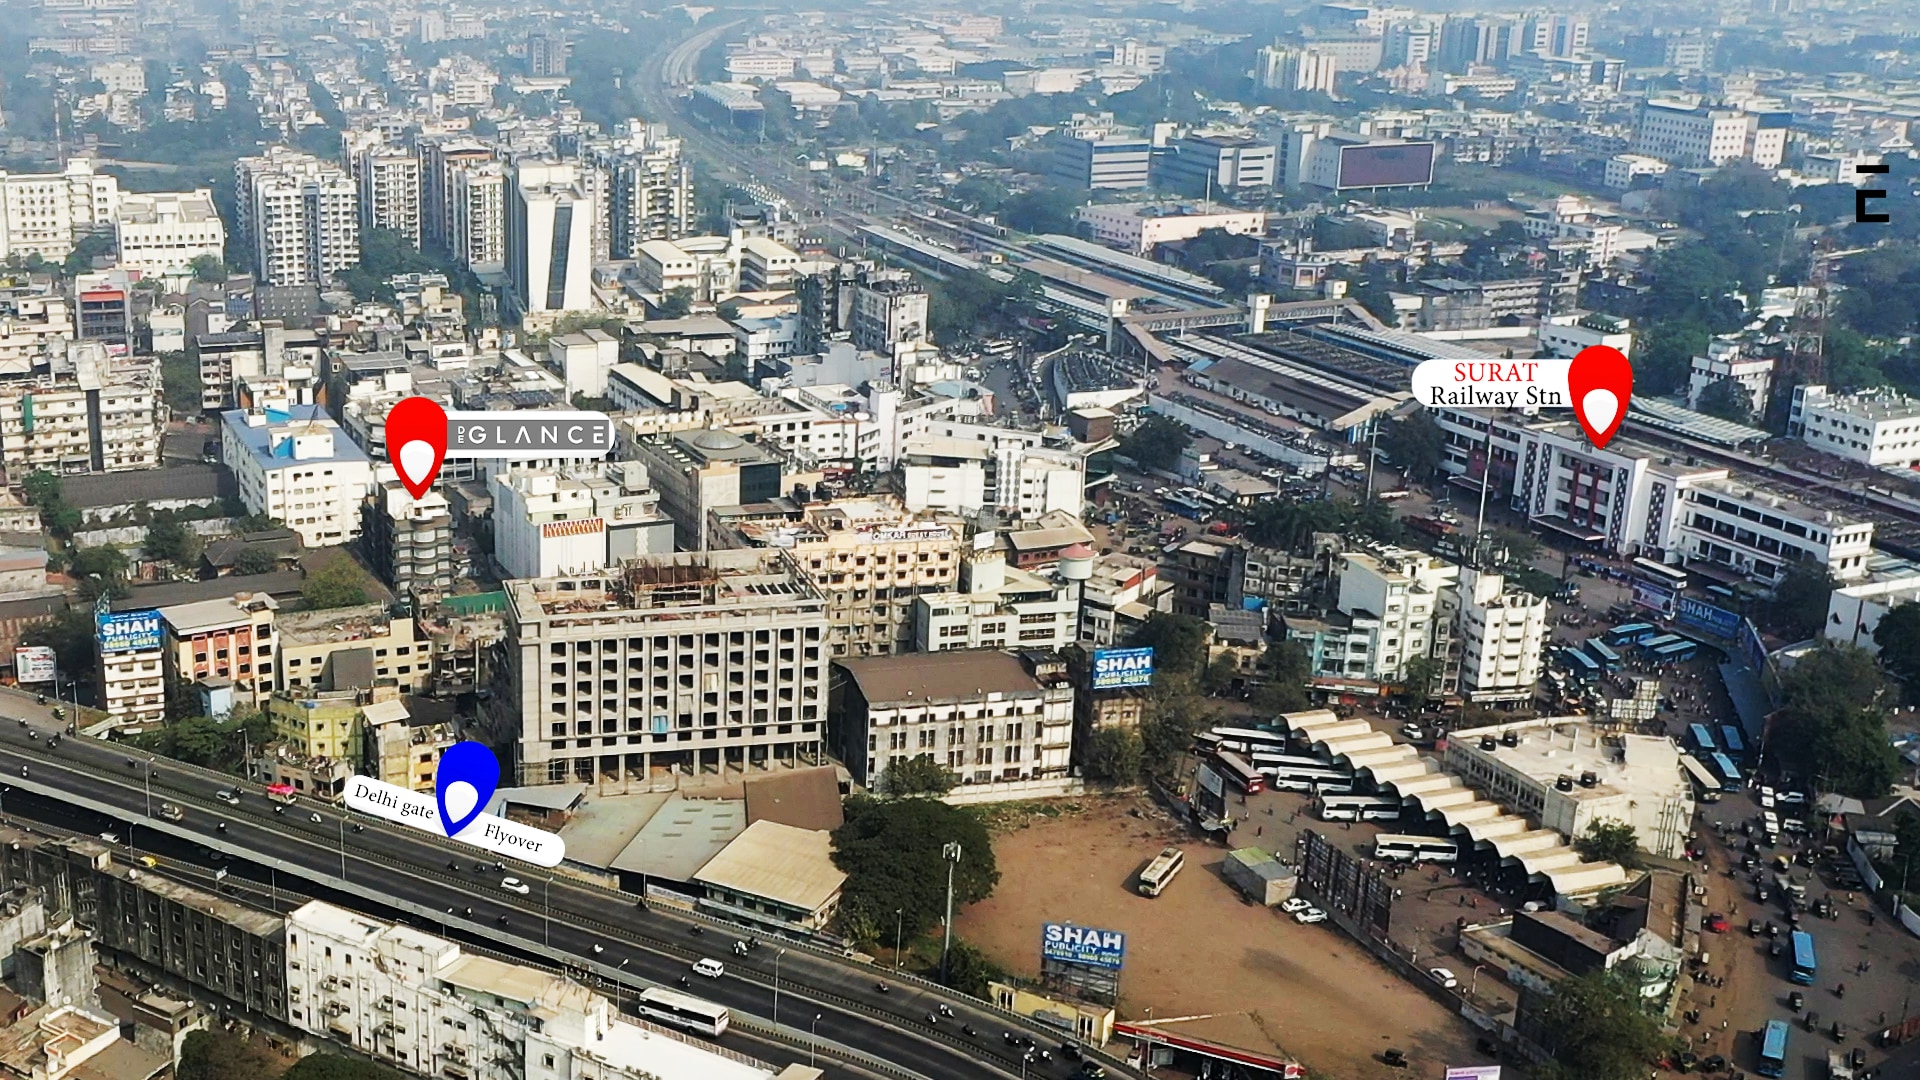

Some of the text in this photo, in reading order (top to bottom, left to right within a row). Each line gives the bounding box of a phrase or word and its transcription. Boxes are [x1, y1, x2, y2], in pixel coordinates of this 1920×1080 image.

[1680, 600, 1713, 621] SHAH
[103, 619, 159, 636] SHAH
[106, 632, 152, 642] PUBLICITY
[1096, 656, 1150, 672] SHAH
[1098, 669, 1144, 678] PUBLICITY
[1045, 925, 1122, 950] SHAH
[1044, 940, 1098, 955] PUBLICITY
